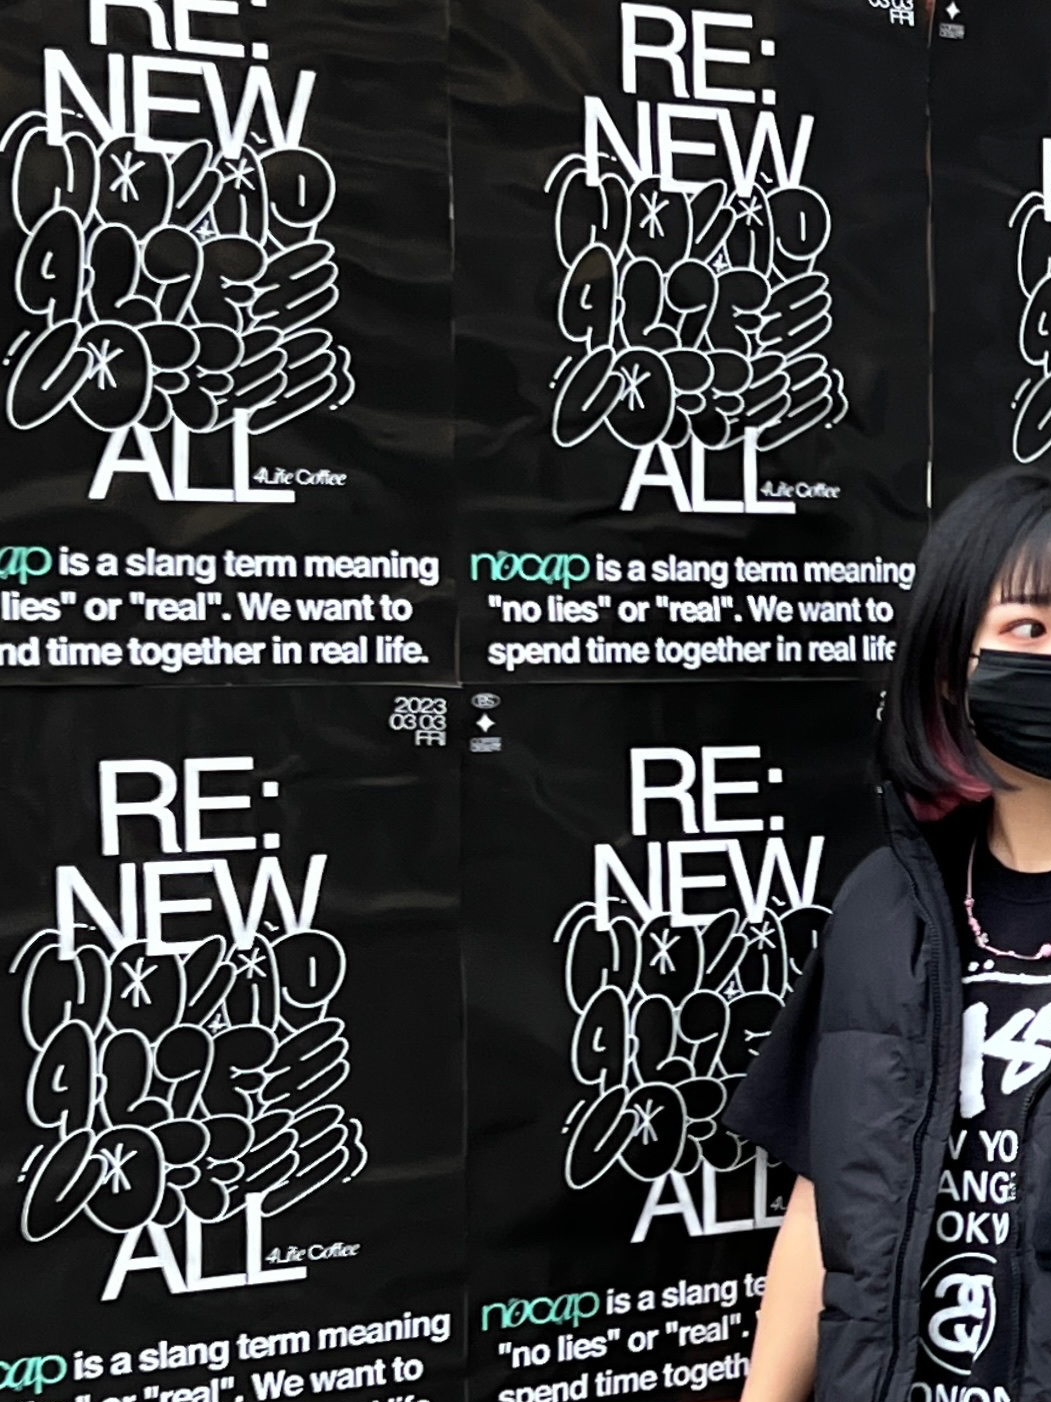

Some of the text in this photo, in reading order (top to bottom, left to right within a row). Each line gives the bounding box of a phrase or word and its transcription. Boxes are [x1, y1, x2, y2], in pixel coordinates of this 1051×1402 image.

[620, 2, 776, 104] RE:
[44, 48, 316, 159] NEW
[583, 96, 814, 198] NEW
[88, 407, 295, 502] ALL
[620, 426, 796, 513] ALL
[58, 545, 91, 577] is
[95, 552, 119, 577] a
[125, 546, 217, 585] slang
[222, 549, 298, 578] term
[304, 549, 440, 587] meaning
[470, 550, 916, 591] nocap is a slang term meaning
[0, 590, 414, 622] lies" or "real". We want to
[487, 594, 894, 624] "no lies" or "real". We want to
[45, 635, 124, 666] time
[126, 635, 267, 673] together
[271, 635, 303, 665] in
[309, 635, 368, 665] real
[375, 634, 429, 664] life.
[487, 634, 857, 672] spend time together in real
[389, 713, 447, 731] 03 03
[394, 696, 448, 715] 2023
[98, 756, 280, 856] RE:
[630, 745, 783, 836] RE:
[56, 853, 327, 961] NEW
[593, 835, 825, 932] NEW
[979, 1130, 1018, 1162] YO
[100, 1193, 307, 1301] ALL
[481, 1291, 600, 1332] nocap
[606, 1288, 631, 1315] is
[636, 1289, 656, 1312] a
[661, 1279, 738, 1309] slang
[73, 1350, 104, 1381] is
[109, 1351, 133, 1376] a
[138, 1340, 230, 1372] slang
[235, 1330, 311, 1360] term
[317, 1311, 451, 1351] meaning
[594, 1369, 659, 1398] time
